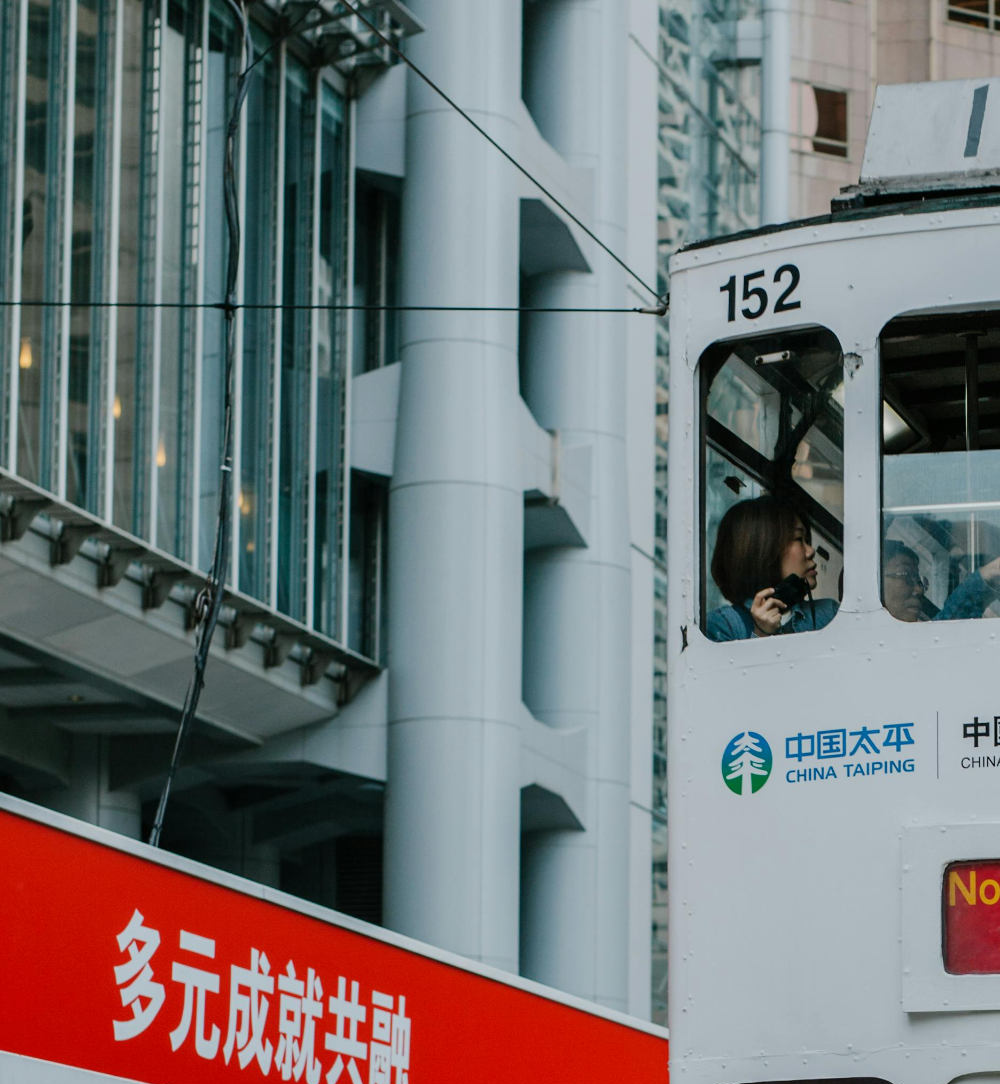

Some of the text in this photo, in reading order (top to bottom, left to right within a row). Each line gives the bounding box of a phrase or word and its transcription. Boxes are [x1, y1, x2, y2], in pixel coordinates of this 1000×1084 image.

[719, 263, 801, 322] 152
[785, 722, 915, 762] 中国太平
[786, 759, 915, 783] CHINA TAIPING
